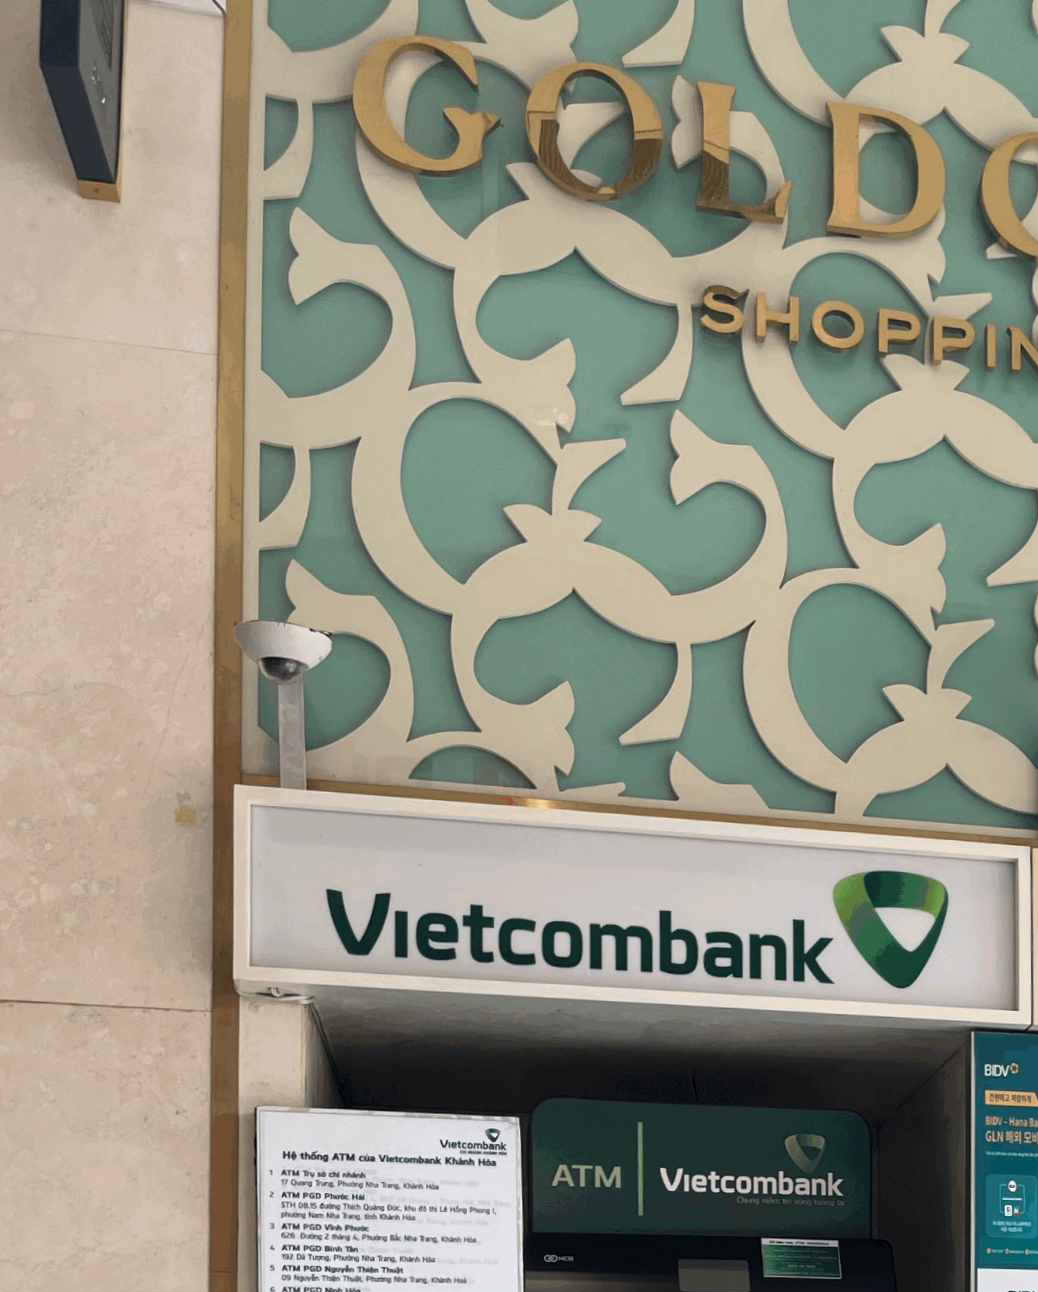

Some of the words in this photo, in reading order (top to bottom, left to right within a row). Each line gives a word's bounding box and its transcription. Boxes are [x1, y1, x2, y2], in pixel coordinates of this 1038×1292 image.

[326, 888, 835, 984] Vietcombank
[984, 1064, 1010, 1077] BIDV
[985, 1116, 1003, 1125] BIDV
[1009, 1117, 1027, 1127] Hana
[985, 1131, 1003, 1142] GLN
[1006, 1131, 1021, 1144] 해외
[440, 1139, 506, 1150] Vietcombank
[283, 1151, 297, 1160] Hệ
[301, 1152, 328, 1162] thống
[359, 1155, 375, 1163] của
[380, 1155, 441, 1165] Vietcombank
[445, 1156, 475, 1166] Khánh
[479, 1158, 497, 1167] Hòa
[291, 1179, 312, 1188] Quang
[316, 1180, 335, 1189] Trung,
[338, 1181, 363, 1189] Phường
[381, 1182, 401, 1190] Trang,
[404, 1182, 423, 1190] Khánh
[551, 1165, 621, 1188] ATM
[660, 1167, 844, 1196] Vietcombank
[737, 1196, 759, 1205] Chung
[325, 1265, 355, 1274] Nguyễn
[358, 1266, 379, 1274] Thiện
